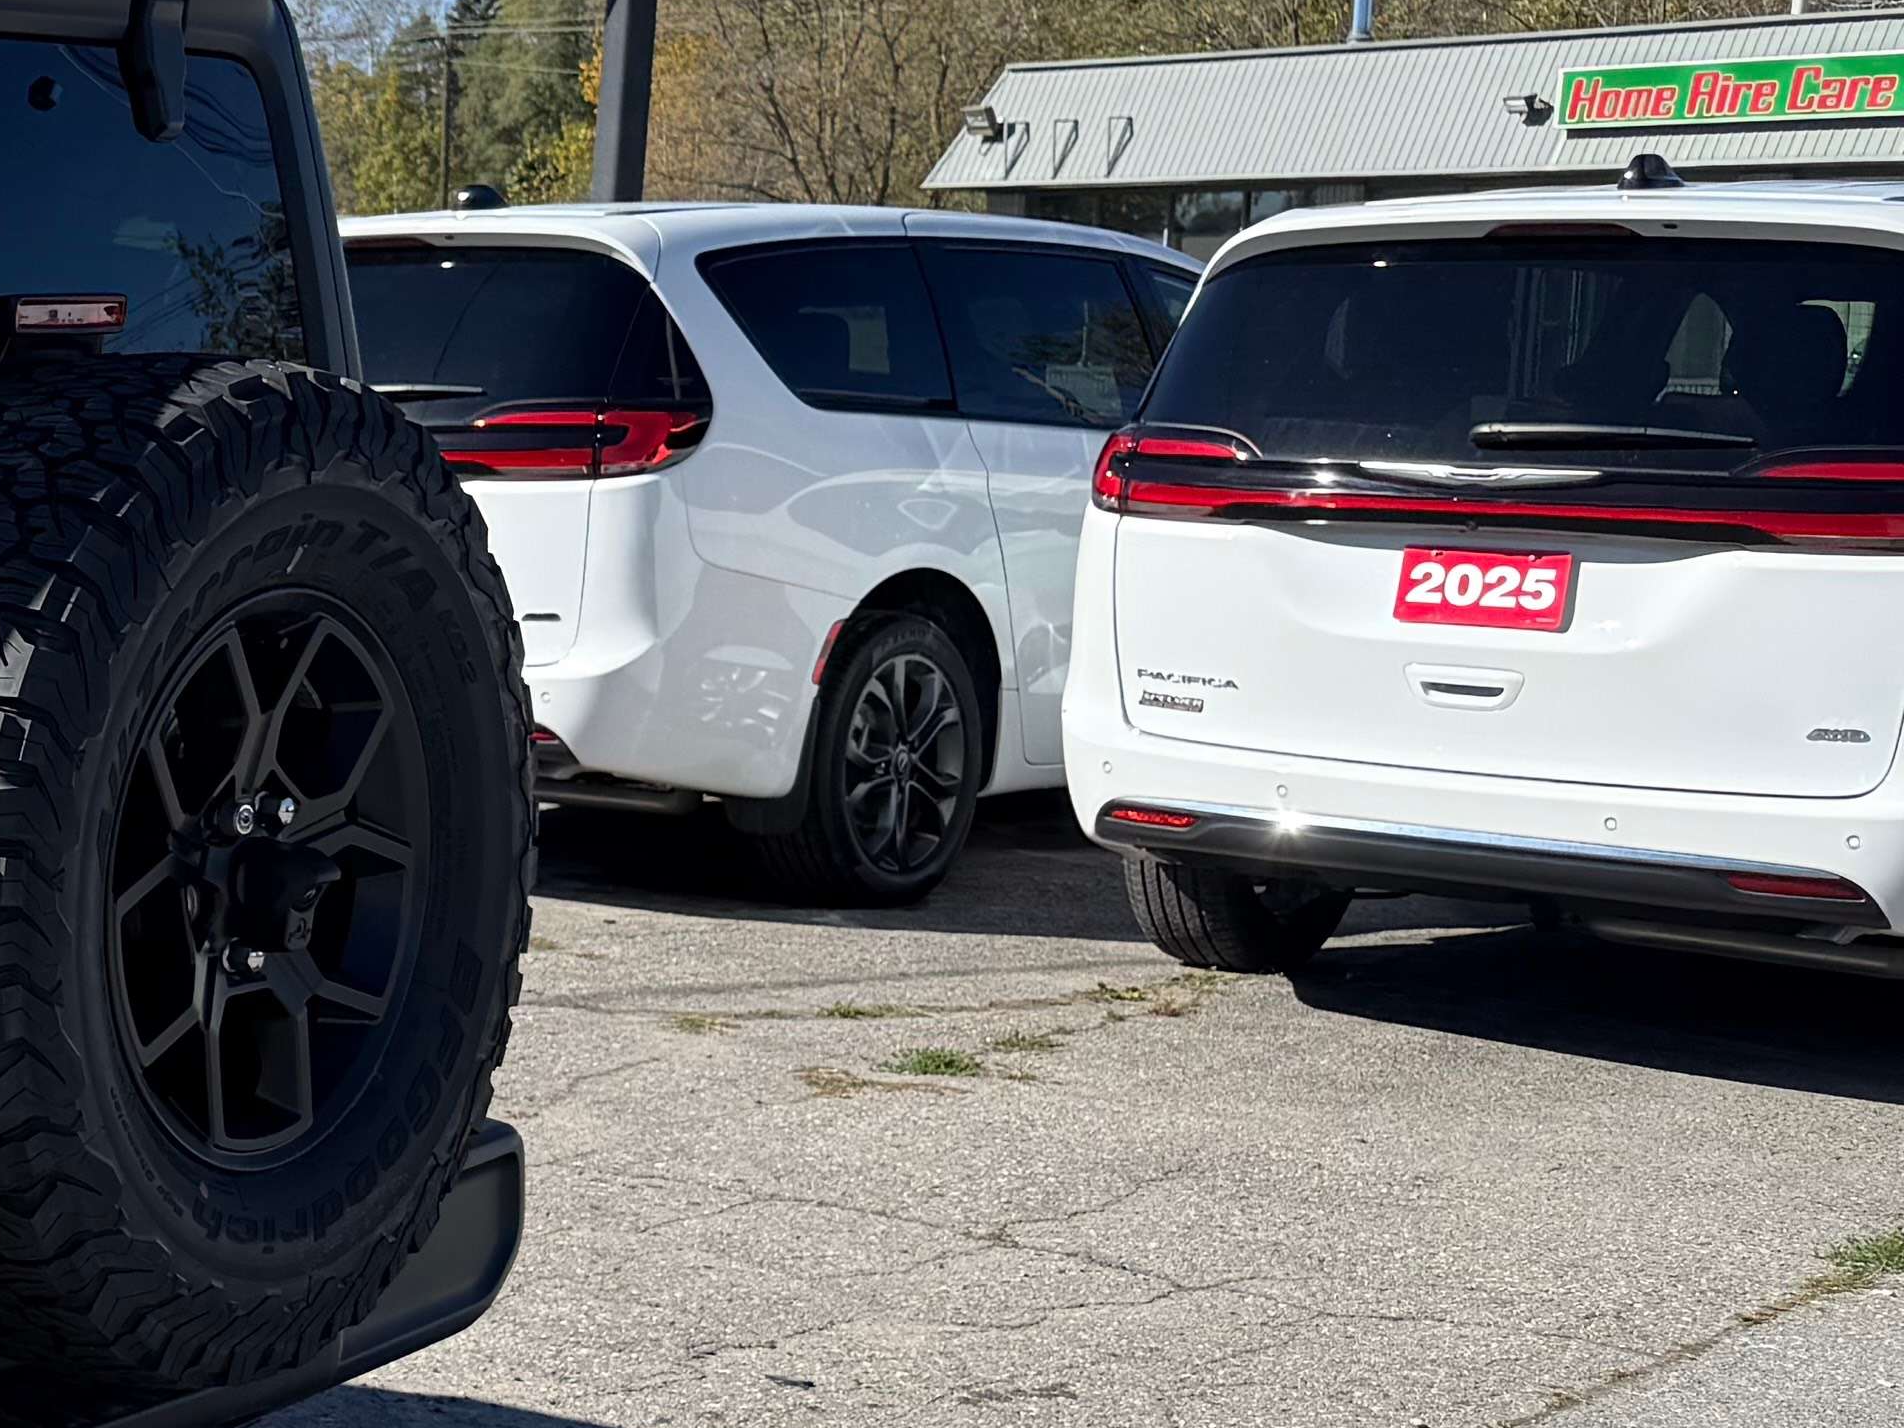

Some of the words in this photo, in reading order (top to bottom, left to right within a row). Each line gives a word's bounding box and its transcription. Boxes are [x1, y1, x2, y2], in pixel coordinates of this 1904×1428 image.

[1566, 77, 1678, 122] Home
[1685, 70, 1779, 119] Aire
[1786, 64, 1899, 114] Care
[1404, 562, 1557, 612] 2025
[1137, 668, 1239, 690] PACIFICA
